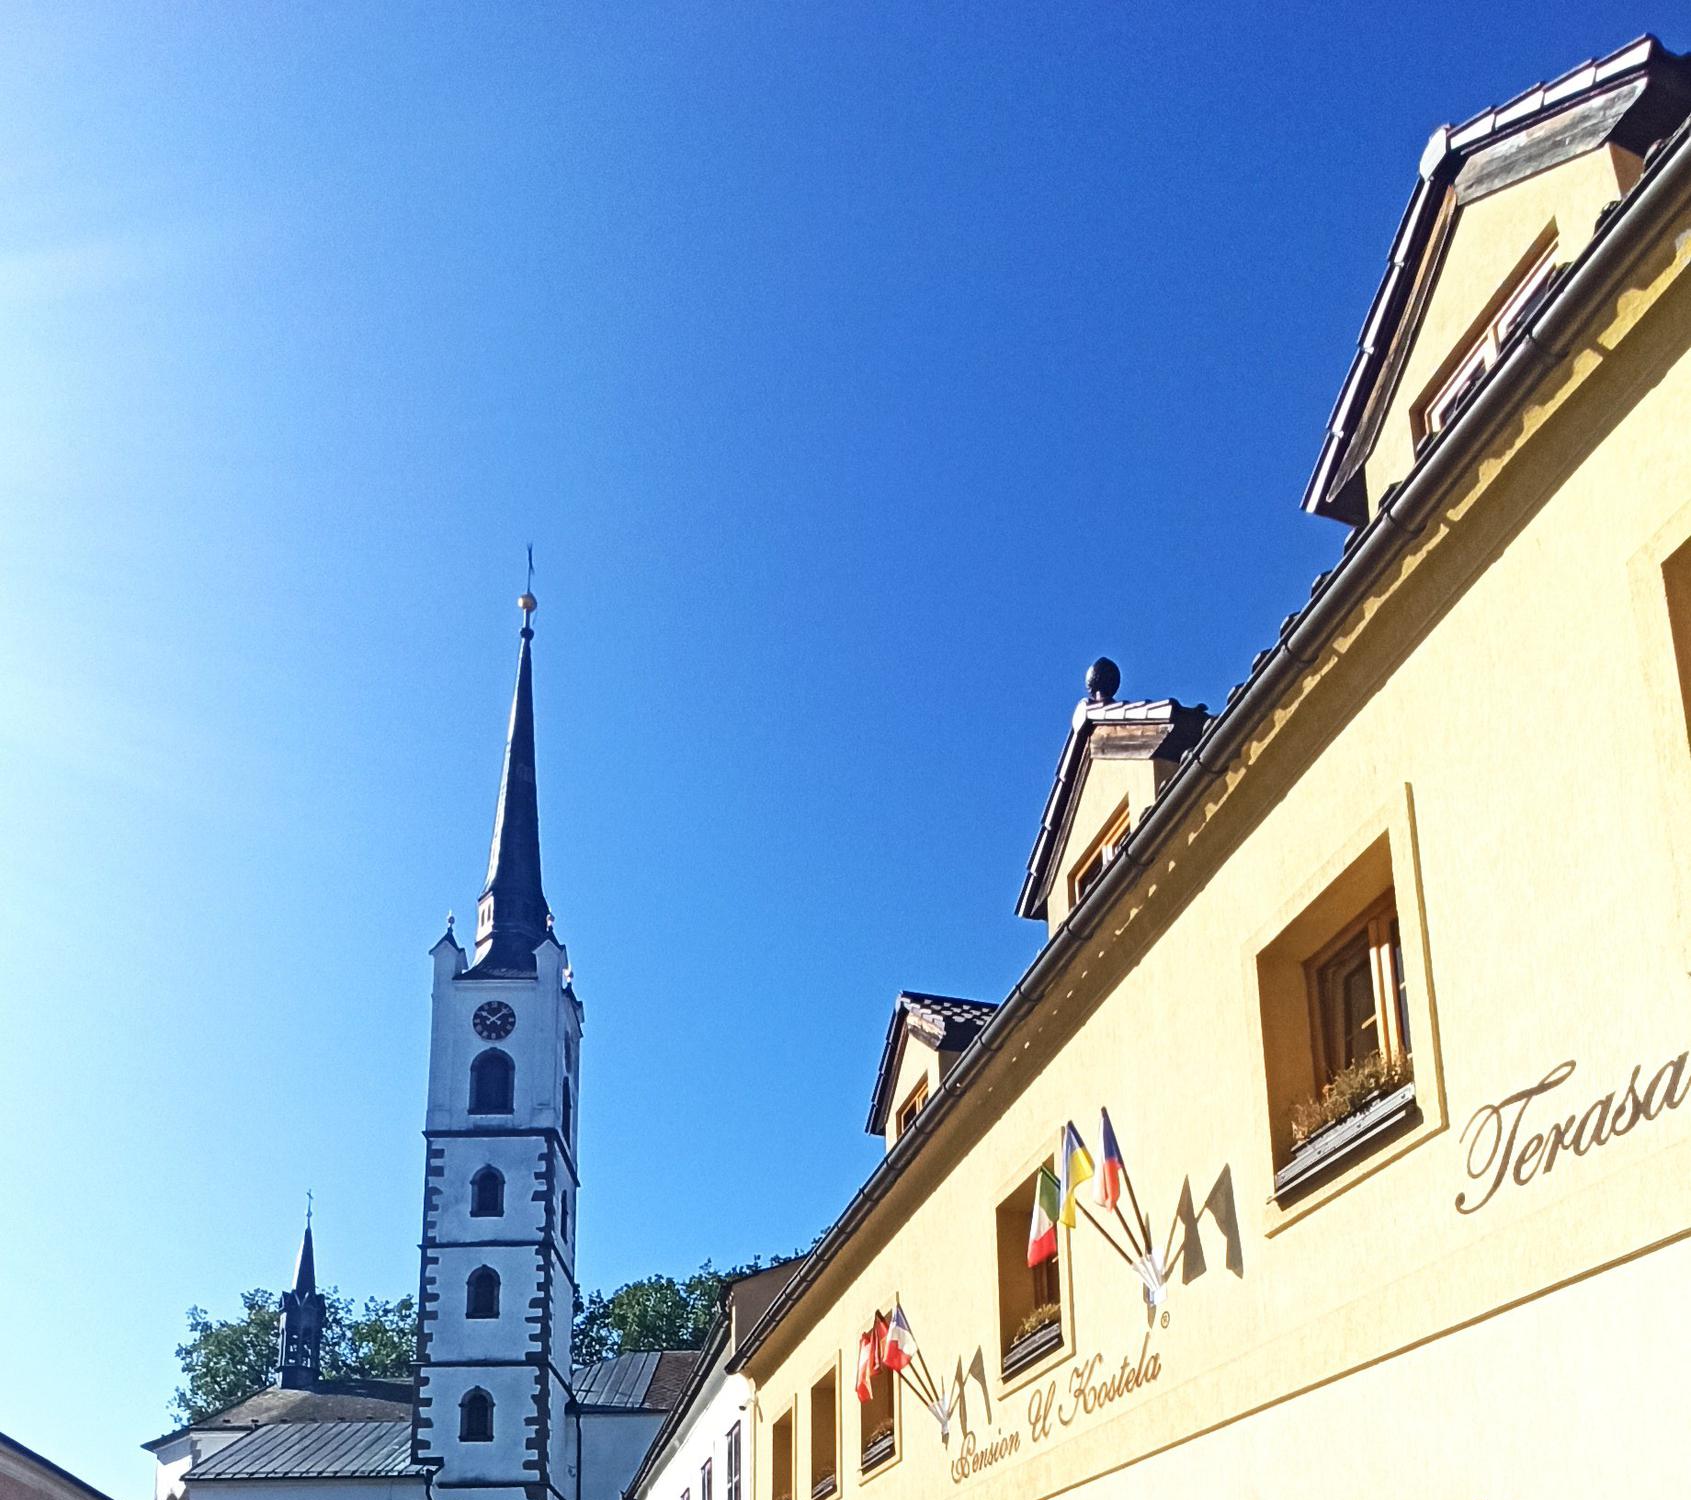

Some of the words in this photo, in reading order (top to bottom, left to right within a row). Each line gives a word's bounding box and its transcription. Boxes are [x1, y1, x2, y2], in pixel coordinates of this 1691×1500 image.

[1455, 1050, 1691, 1215] Terasa
[951, 1428, 1020, 1484] Pension
[1028, 1381, 1057, 1442] U
[1058, 1338, 1161, 1426] Kostela
